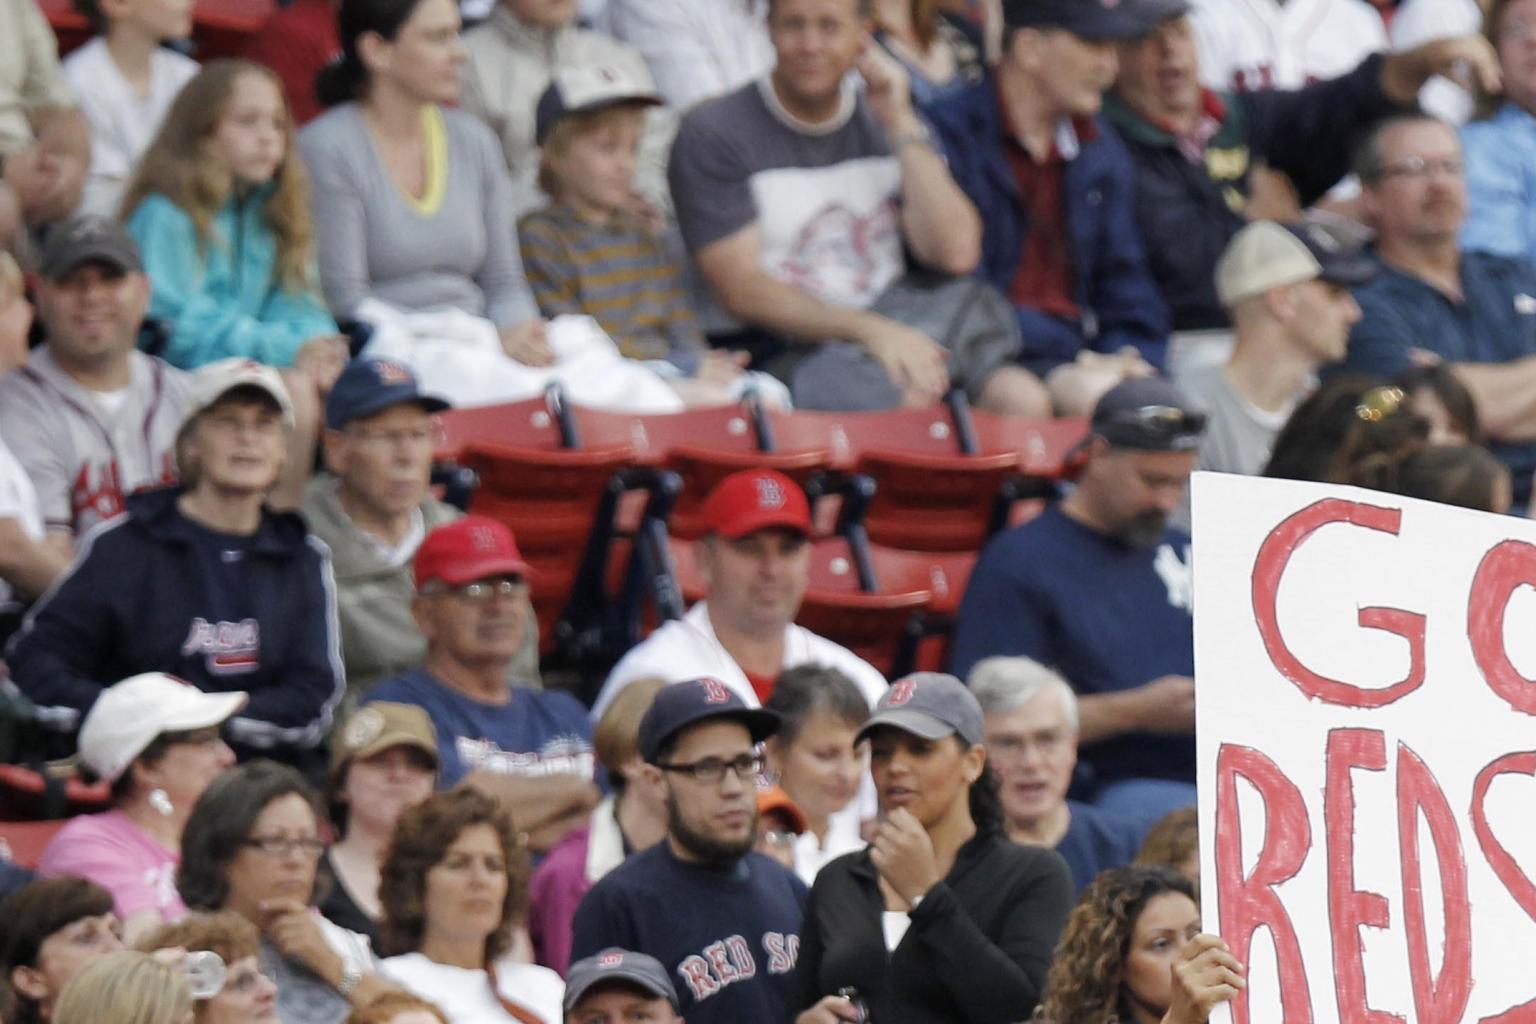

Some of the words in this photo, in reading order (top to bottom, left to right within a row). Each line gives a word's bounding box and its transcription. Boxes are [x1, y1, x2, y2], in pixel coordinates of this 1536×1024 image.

[755, 477, 785, 508] B
[702, 679, 730, 704] B
[677, 935, 756, 1001] RED
